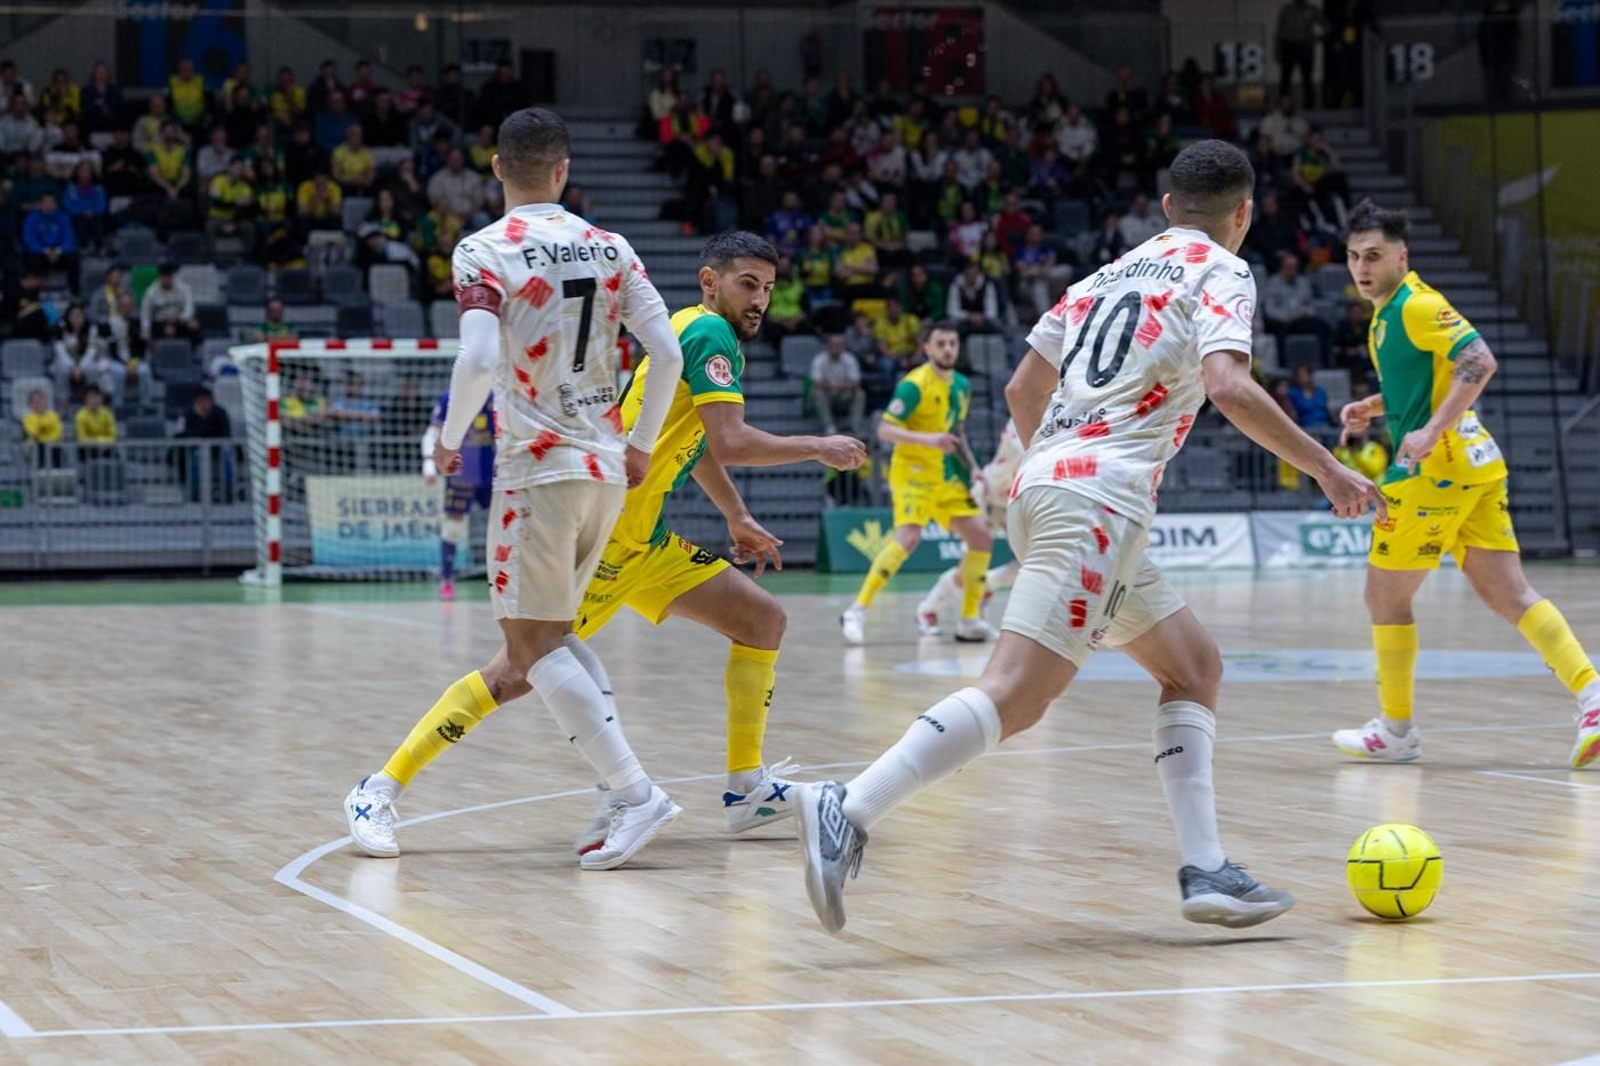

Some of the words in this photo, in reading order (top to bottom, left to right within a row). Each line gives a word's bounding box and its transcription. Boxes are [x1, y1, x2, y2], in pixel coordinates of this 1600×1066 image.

[1218, 42, 1264, 81] 18
[1388, 42, 1435, 81] 18
[562, 277, 597, 373] 7
[1059, 290, 1142, 388] 10
[335, 496, 439, 518] SIERRAS
[337, 520, 371, 540] DE
